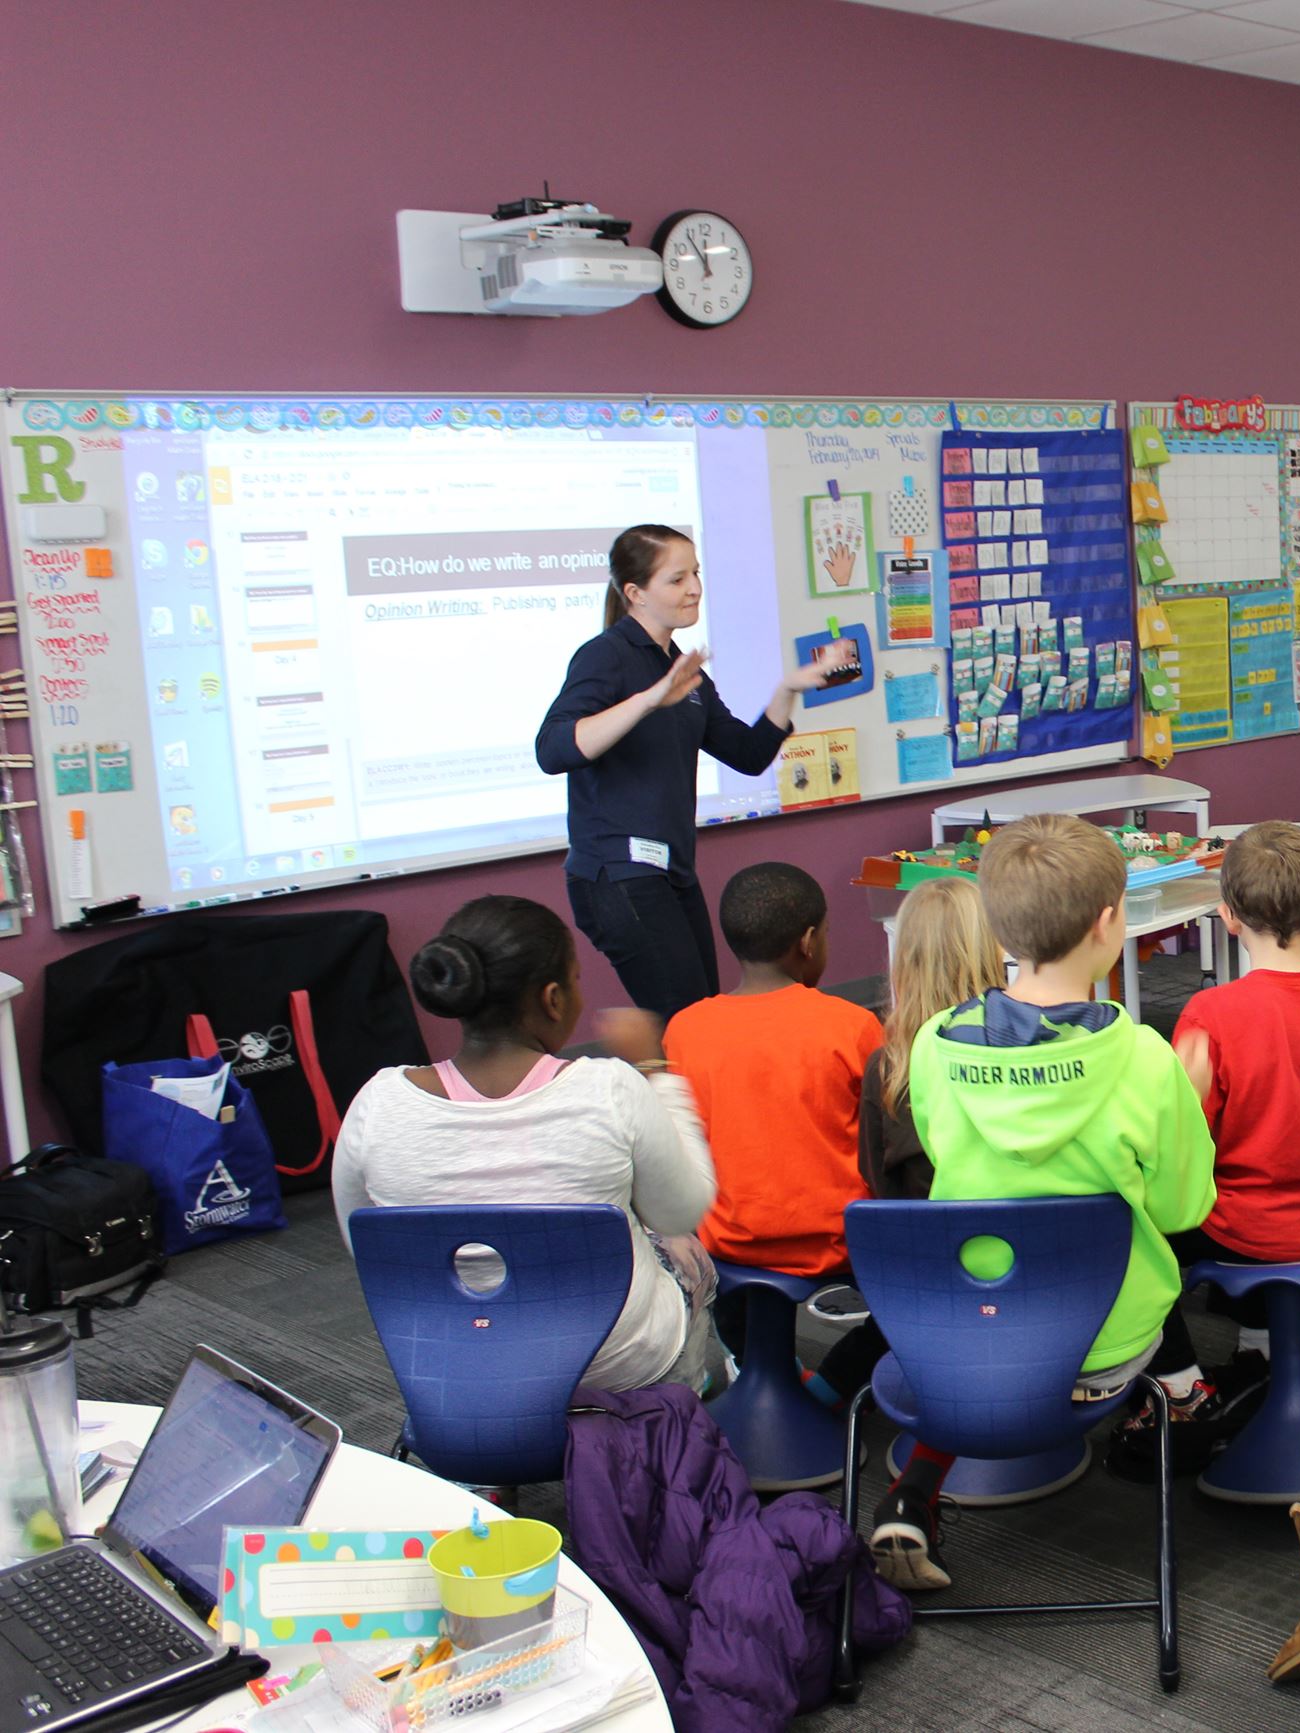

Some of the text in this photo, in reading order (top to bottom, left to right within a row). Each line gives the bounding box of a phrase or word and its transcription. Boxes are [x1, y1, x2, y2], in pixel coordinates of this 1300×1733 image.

[699, 223, 712, 237] 12
[674, 242, 688, 256] 10
[730, 247, 738, 261] 2
[669, 258, 679, 272] 9
[734, 266, 743, 279] 3
[676, 277, 685, 290] 8
[730, 284, 738, 296] 4
[688, 292, 697, 306] 7
[720, 296, 729, 310] 5
[703, 301, 713, 314] 6
[11, 435, 86, 504] R
[443, 554, 464, 574] do
[468, 558, 491, 572] we
[494, 552, 532, 571] write
[539, 556, 559, 569] an
[364, 602, 423, 620] Opinion
[492, 590, 557, 614] Publishing
[780, 749, 815, 761] ANTHONY
[950, 1060, 1085, 1086] UNDER ARMOUR
